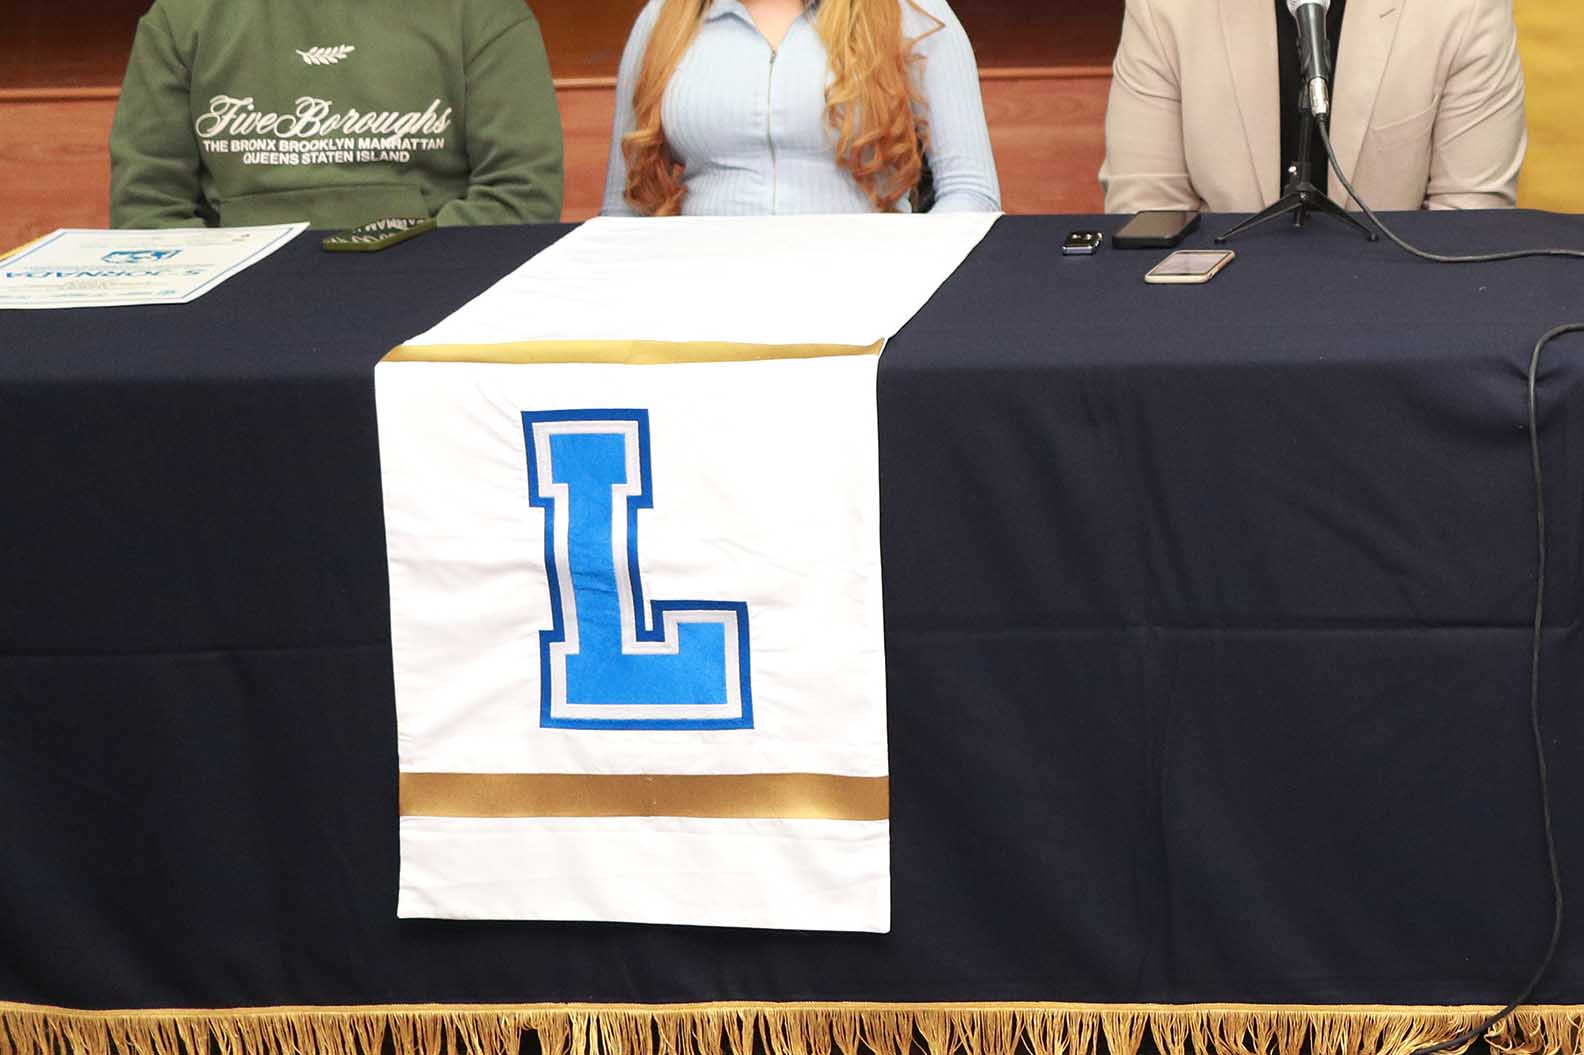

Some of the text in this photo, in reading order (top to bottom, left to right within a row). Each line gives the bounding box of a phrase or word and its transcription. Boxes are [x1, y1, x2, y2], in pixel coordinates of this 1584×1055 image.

[195, 94, 452, 144] Five Boroughs
[202, 137, 445, 153] THE BRONX BROOKLYN MANHATTAN
[243, 149, 410, 165] QUEENS STATEN ISLAND
[521, 409, 754, 730] L
